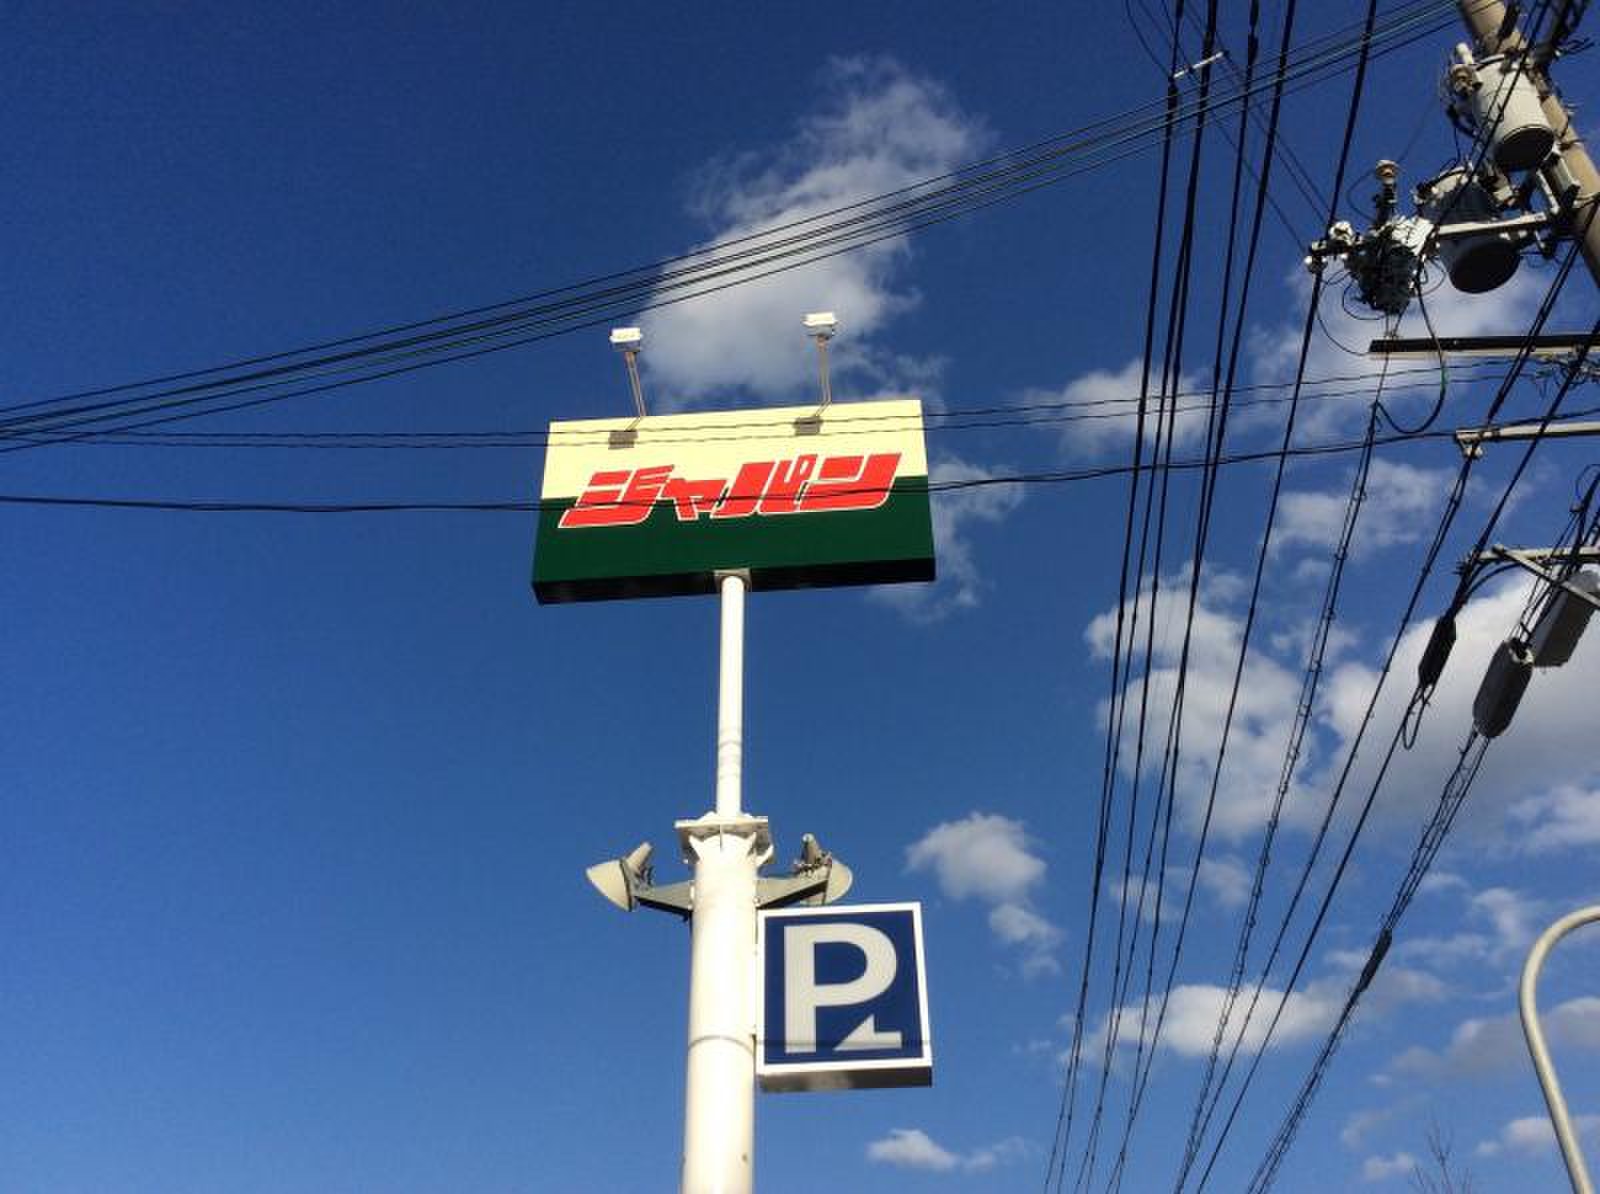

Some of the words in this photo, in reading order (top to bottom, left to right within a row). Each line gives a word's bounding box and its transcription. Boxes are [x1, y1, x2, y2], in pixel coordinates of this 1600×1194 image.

[558, 453, 902, 528] ジャパン
[784, 923, 897, 1054] P
